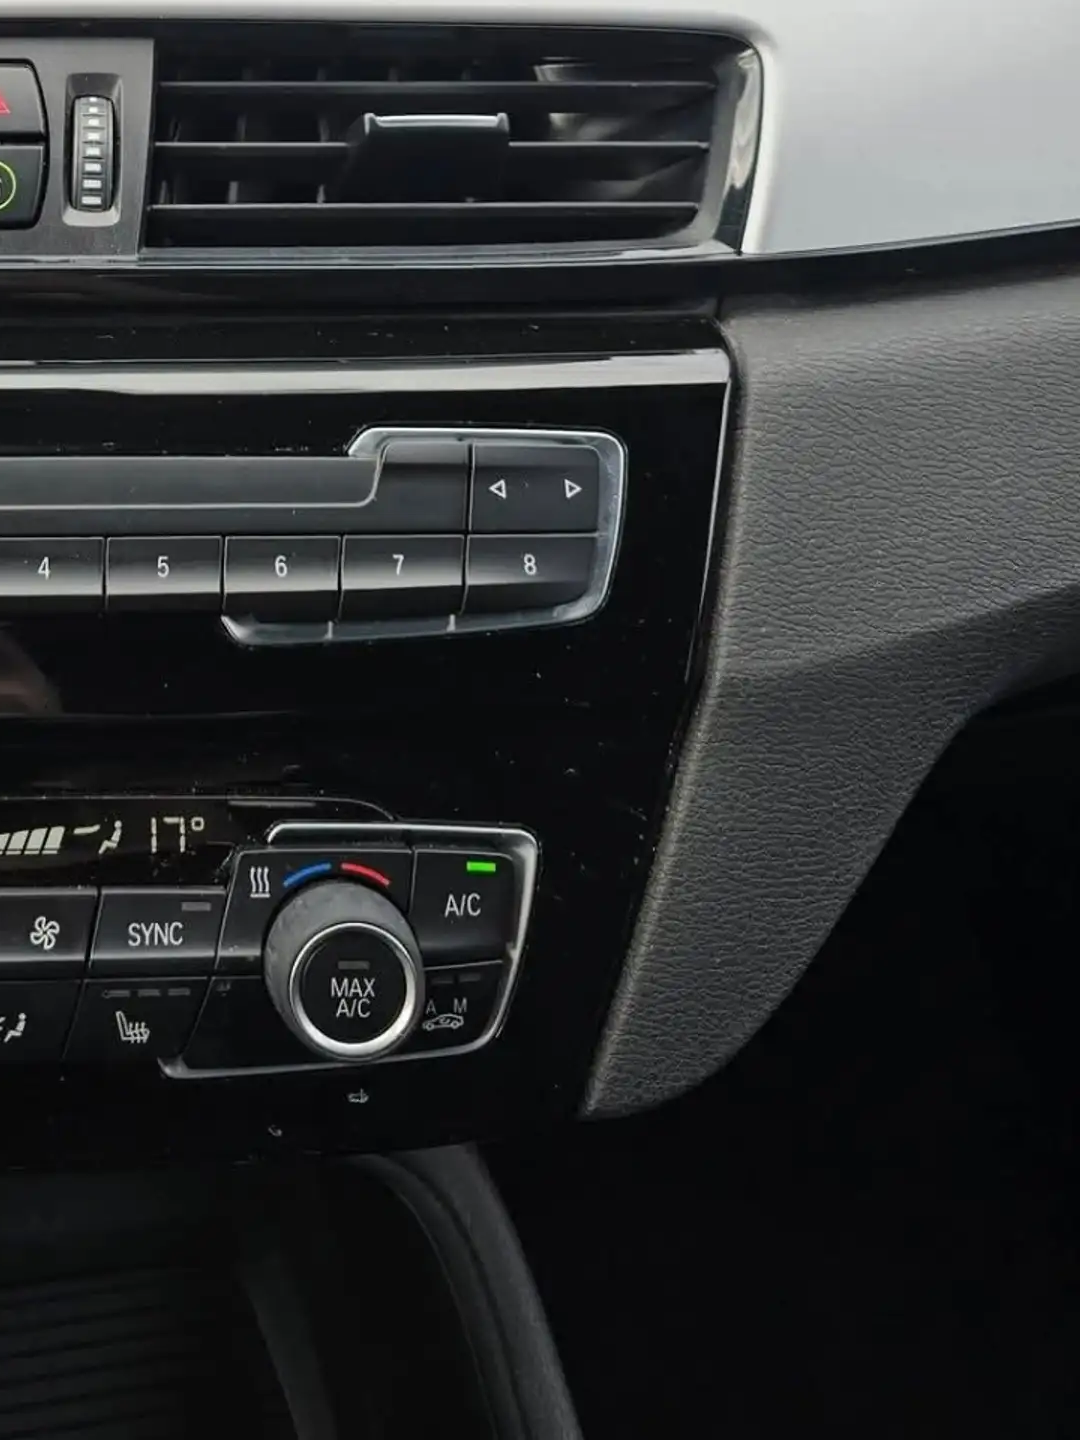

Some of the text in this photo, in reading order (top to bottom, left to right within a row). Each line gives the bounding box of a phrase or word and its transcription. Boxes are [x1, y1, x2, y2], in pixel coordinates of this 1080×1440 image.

[37, 556, 51, 579] 4
[156, 556, 170, 578] 5
[274, 554, 289, 578] 6
[393, 554, 406, 576] 7
[523, 553, 539, 576] 8
[444, 893, 482, 917] A/C
[127, 921, 184, 946] SYNC
[330, 978, 376, 998] MAX
[336, 998, 371, 1018] A/C
[453, 997, 468, 1014] M
